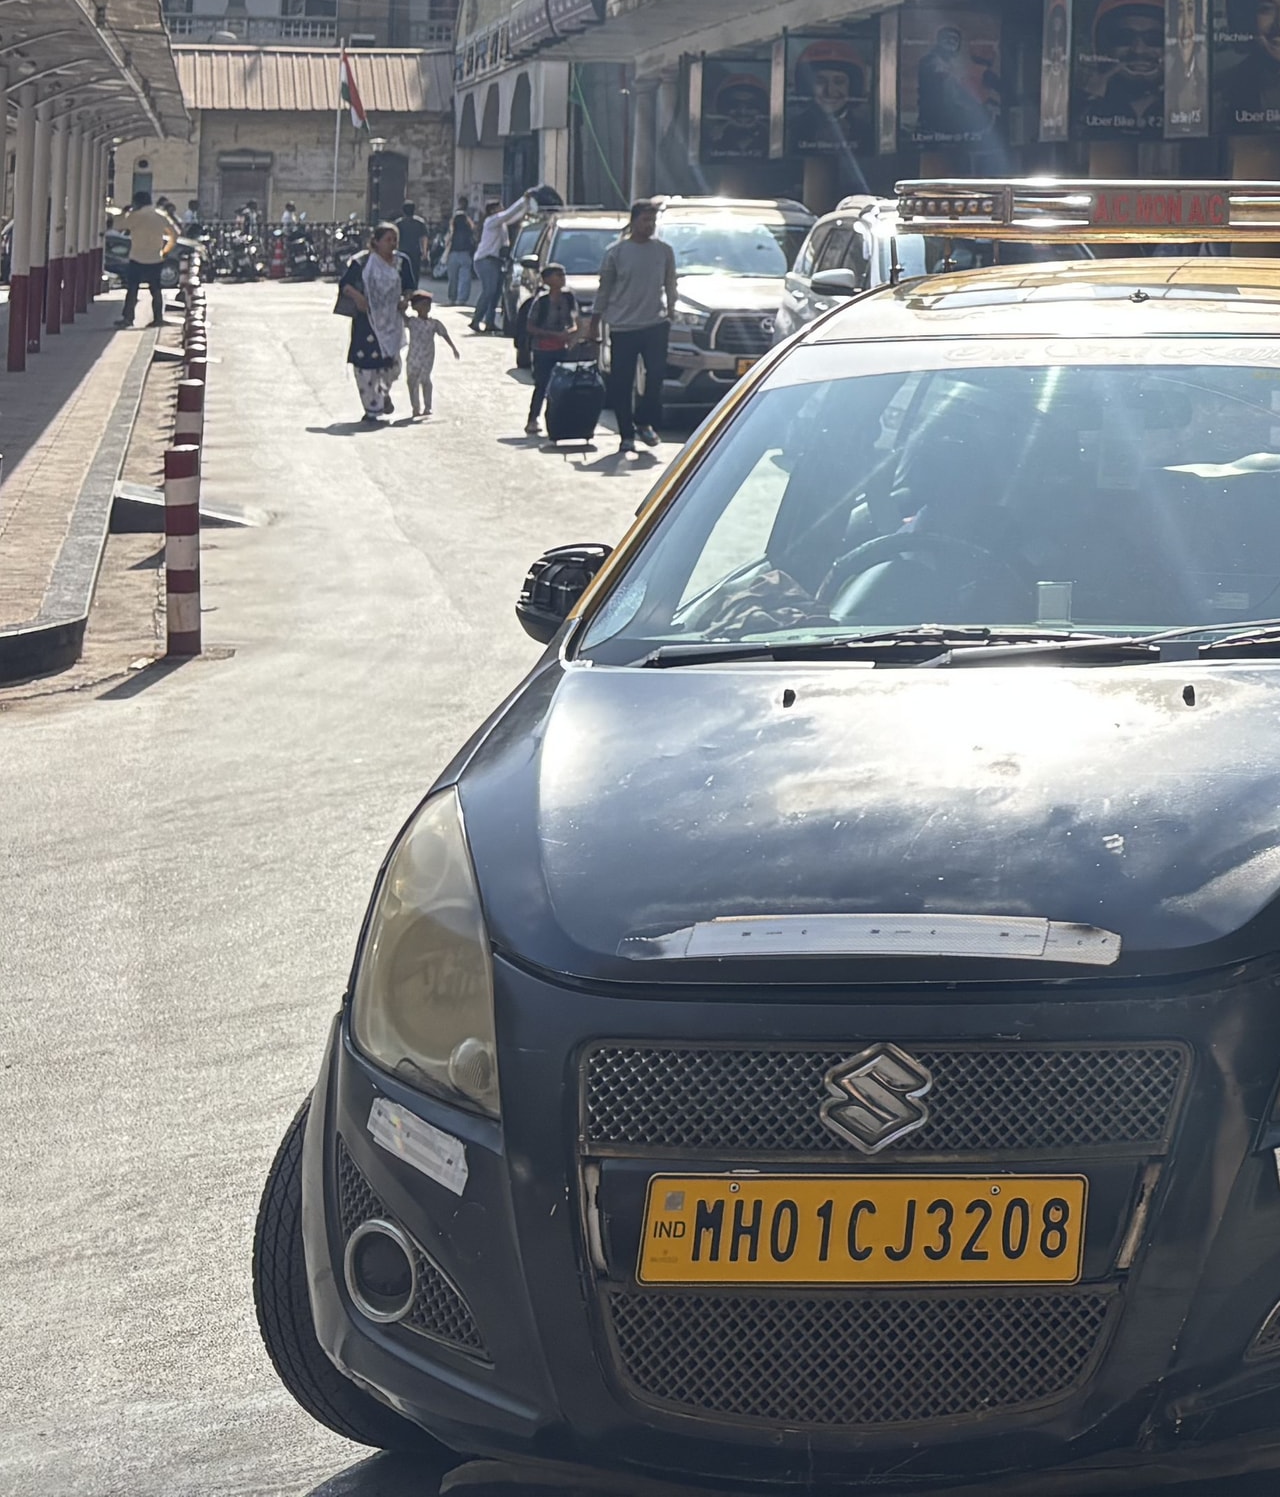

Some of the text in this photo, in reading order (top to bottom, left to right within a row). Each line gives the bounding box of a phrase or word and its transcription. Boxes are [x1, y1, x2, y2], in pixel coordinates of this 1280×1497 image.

[1235, 110, 1265, 122] Uber
[1136, 194, 1182, 224] NON
[653, 1220, 686, 1239] IND
[691, 1198, 1070, 1264] MH01CJ3208
